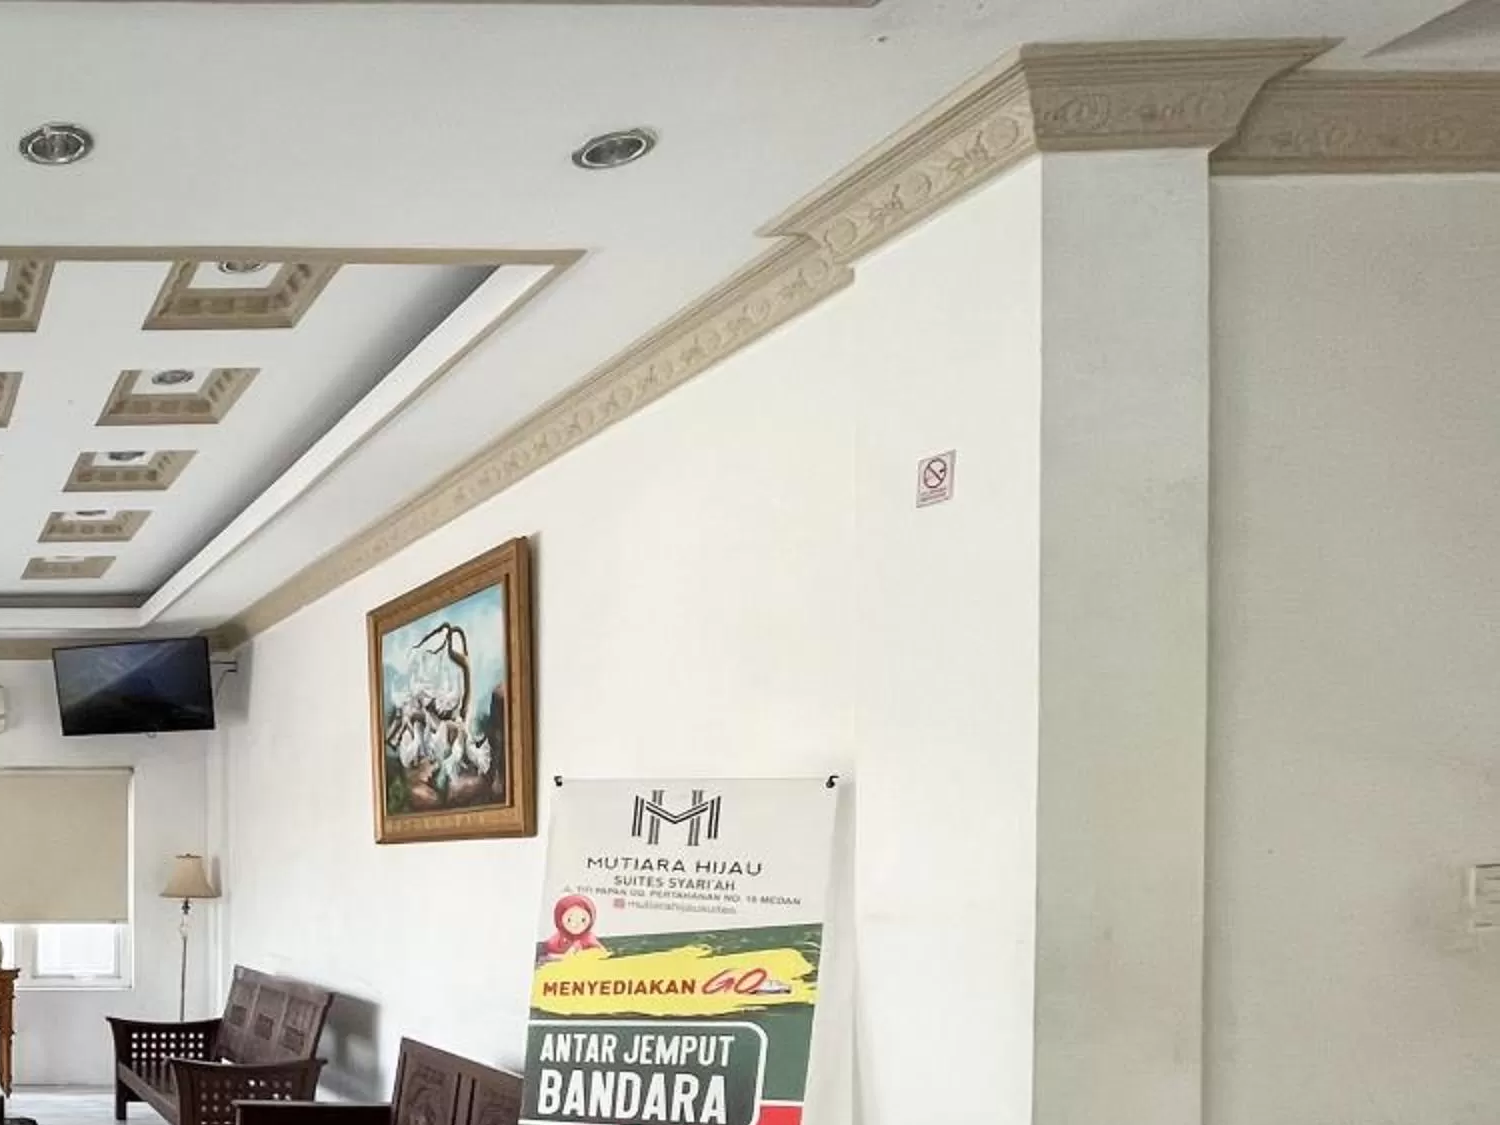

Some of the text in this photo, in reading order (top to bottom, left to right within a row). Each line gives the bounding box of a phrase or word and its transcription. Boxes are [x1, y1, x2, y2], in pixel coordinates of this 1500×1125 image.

[587, 857, 762, 876] MUTIARA HIJAU
[613, 875, 736, 891] SUITES SYARI'AH
[542, 979, 696, 997] MENYEDIAKAN
[539, 1033, 735, 1068] ANTAR JEMPUT
[537, 1069, 728, 1125] BANDARA
